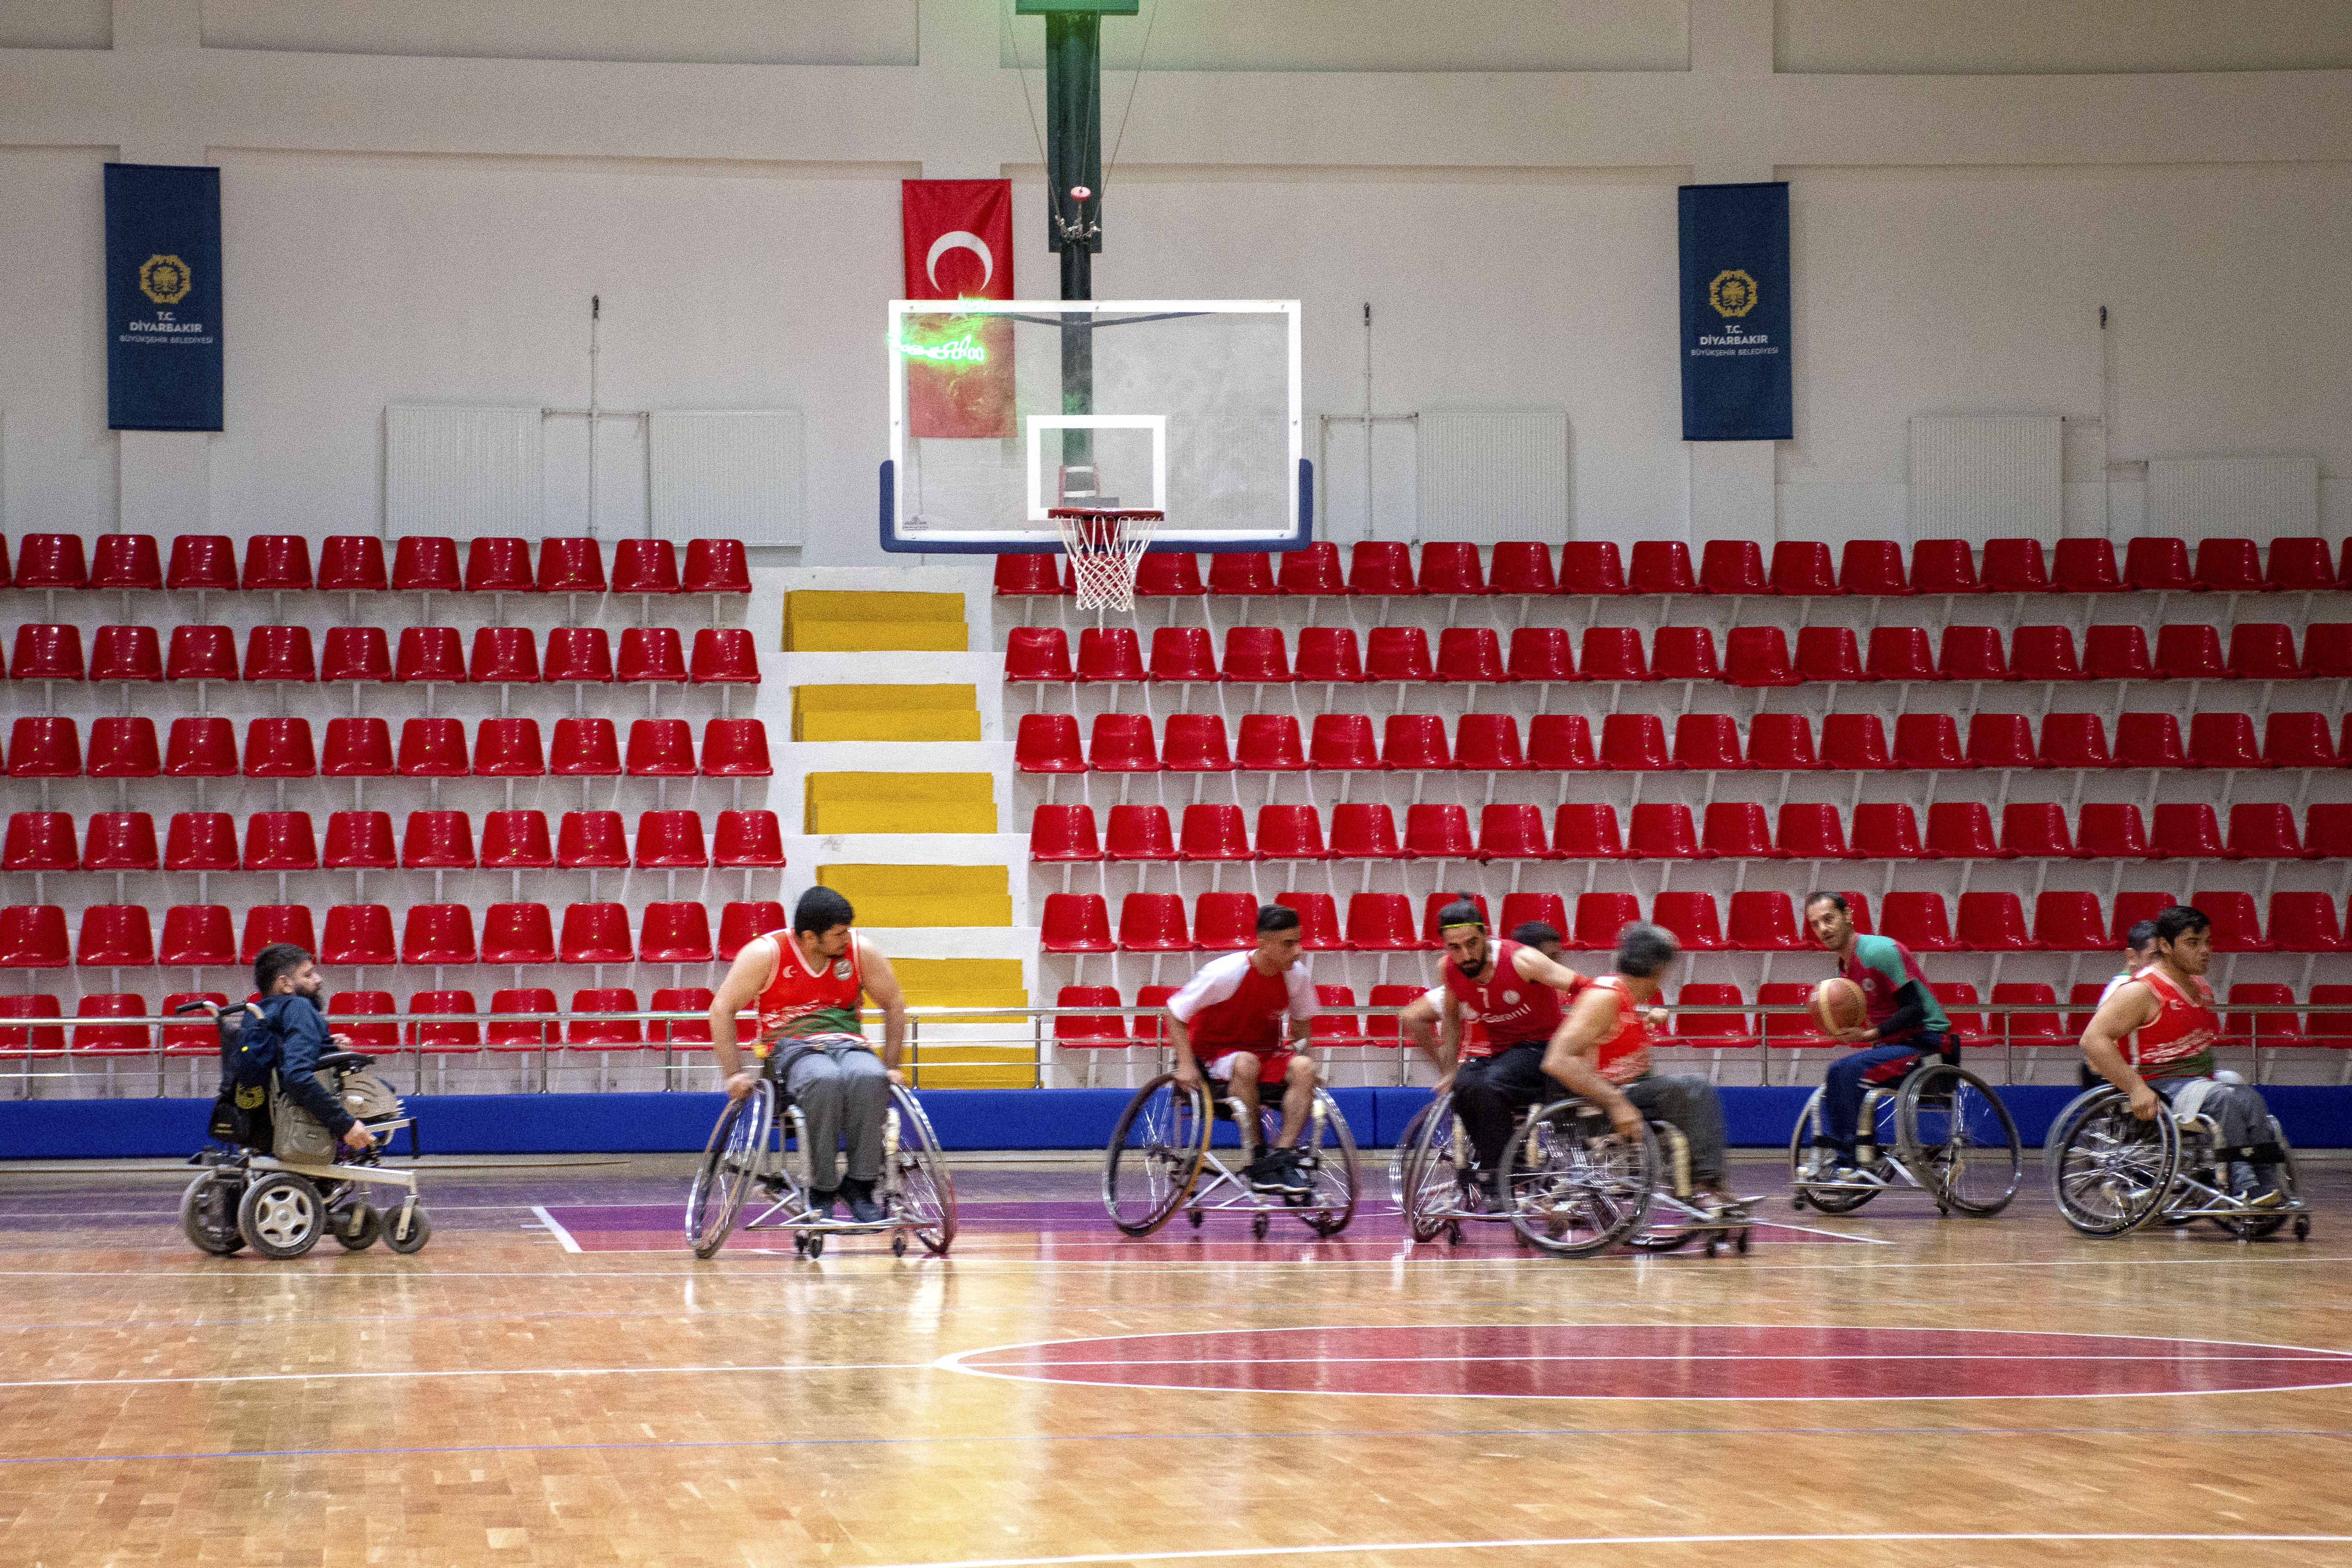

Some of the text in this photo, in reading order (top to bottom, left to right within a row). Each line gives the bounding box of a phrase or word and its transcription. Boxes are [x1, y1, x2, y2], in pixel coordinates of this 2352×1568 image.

[157, 311, 176, 320] T.C.
[129, 320, 202, 333] DİYARBAKIR
[1725, 325, 1743, 334] T.C.
[1700, 334, 1768, 345] DİYARBAKIR
